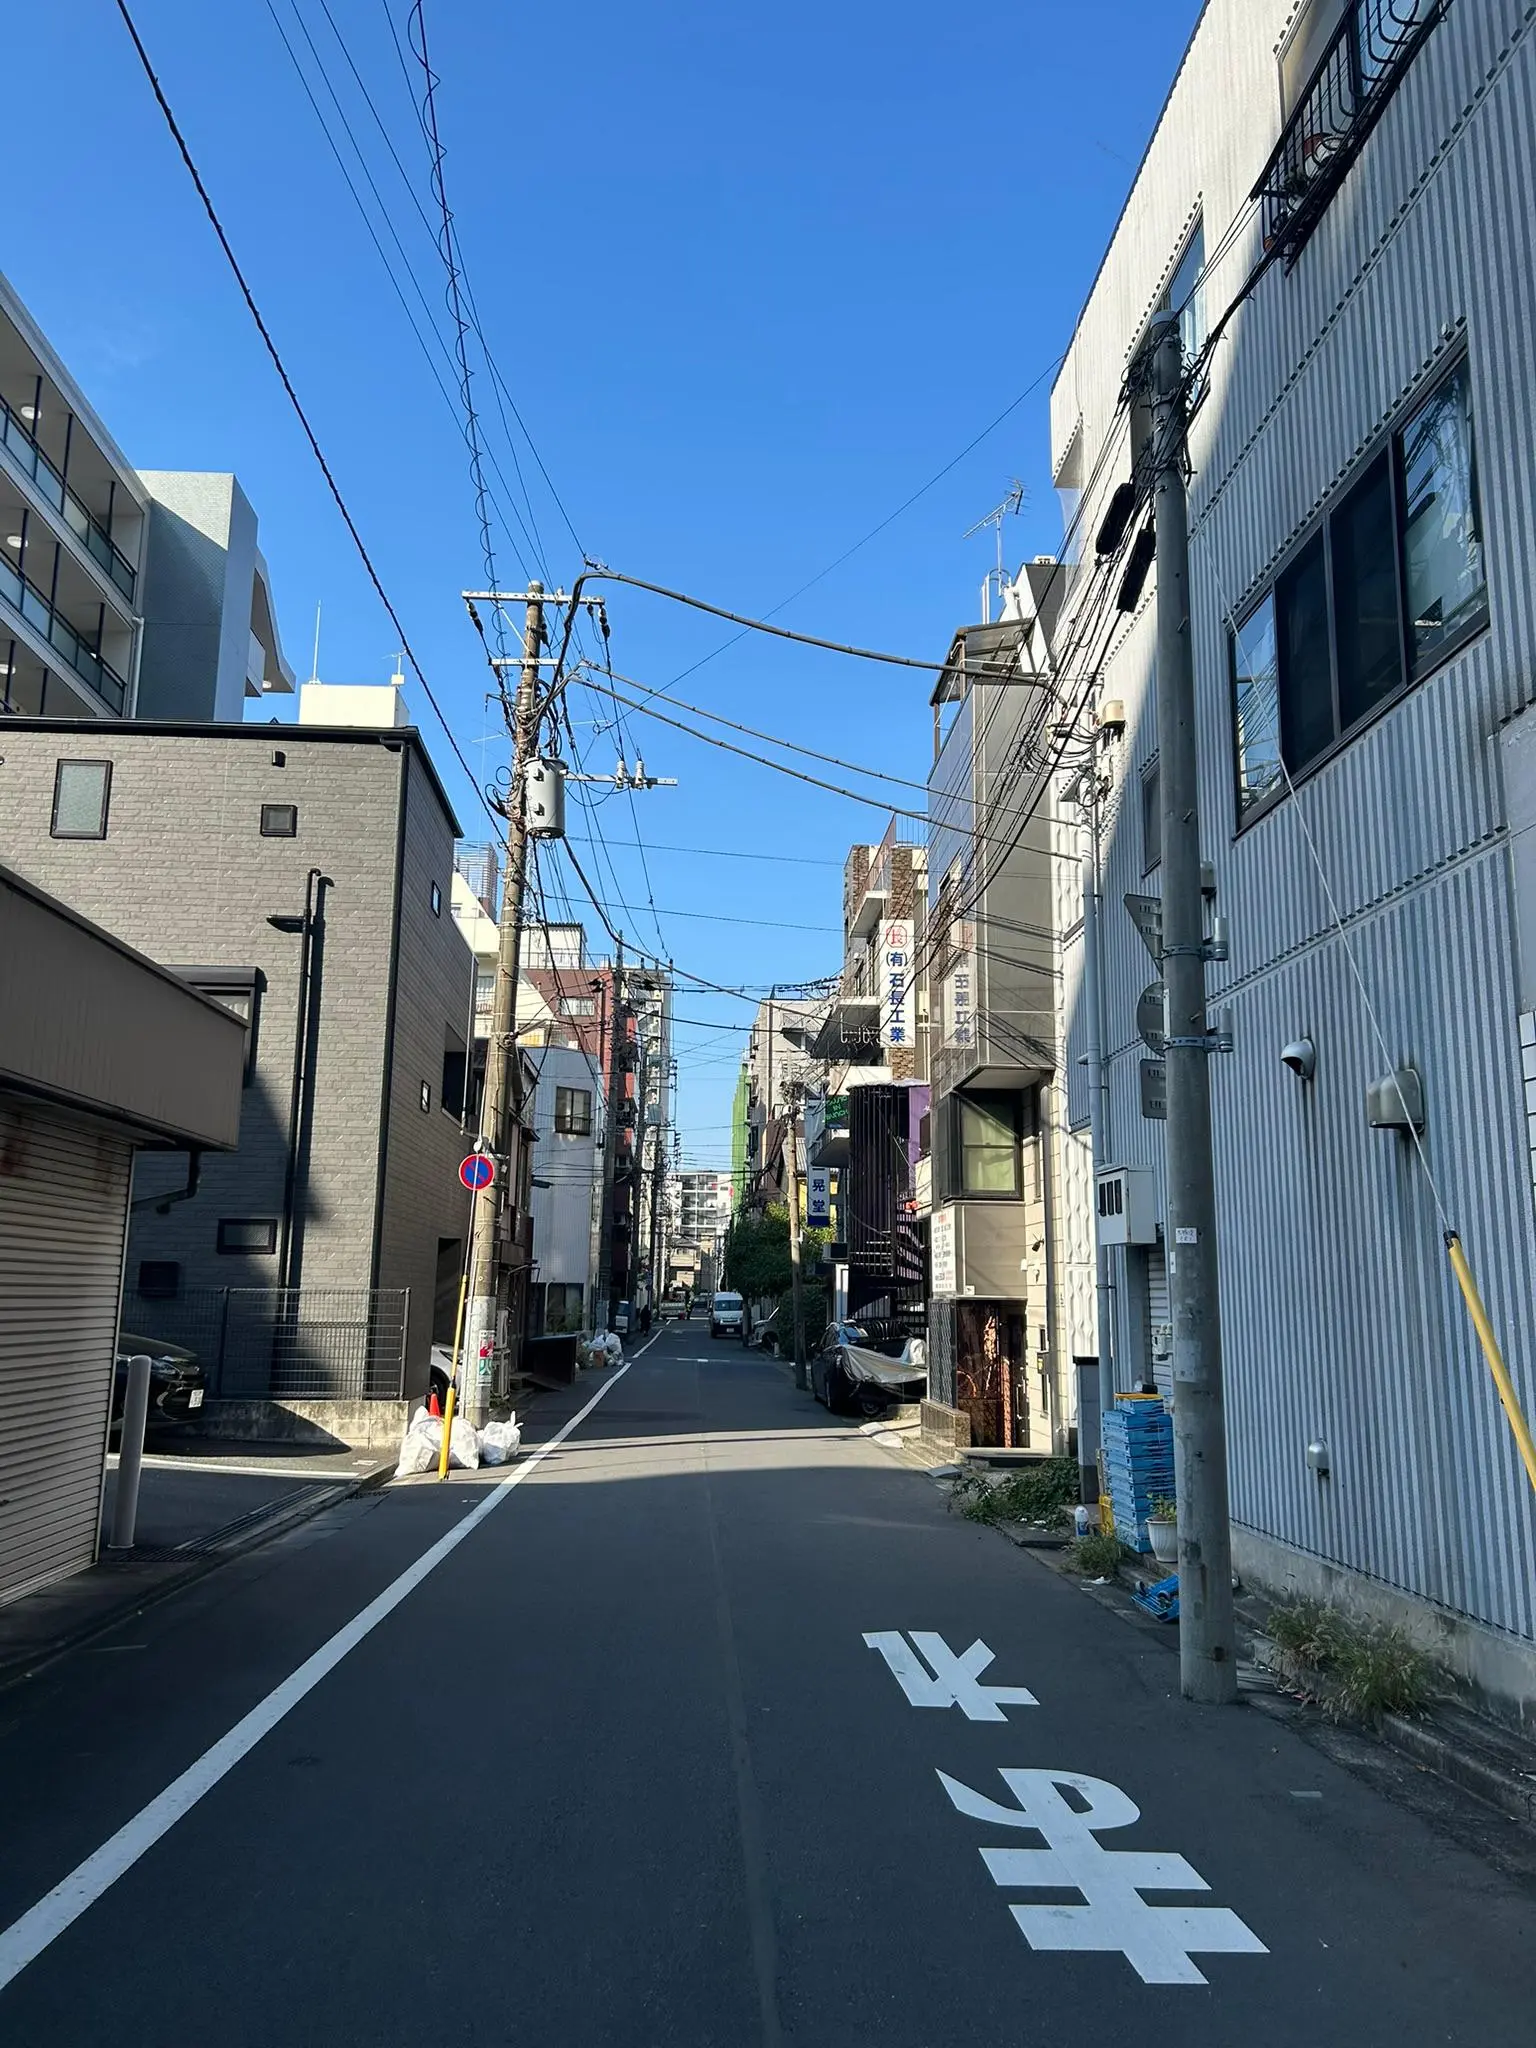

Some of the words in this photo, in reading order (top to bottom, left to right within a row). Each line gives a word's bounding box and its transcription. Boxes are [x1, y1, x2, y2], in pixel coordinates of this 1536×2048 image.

[886, 952, 908, 1042] (有)石長工業
